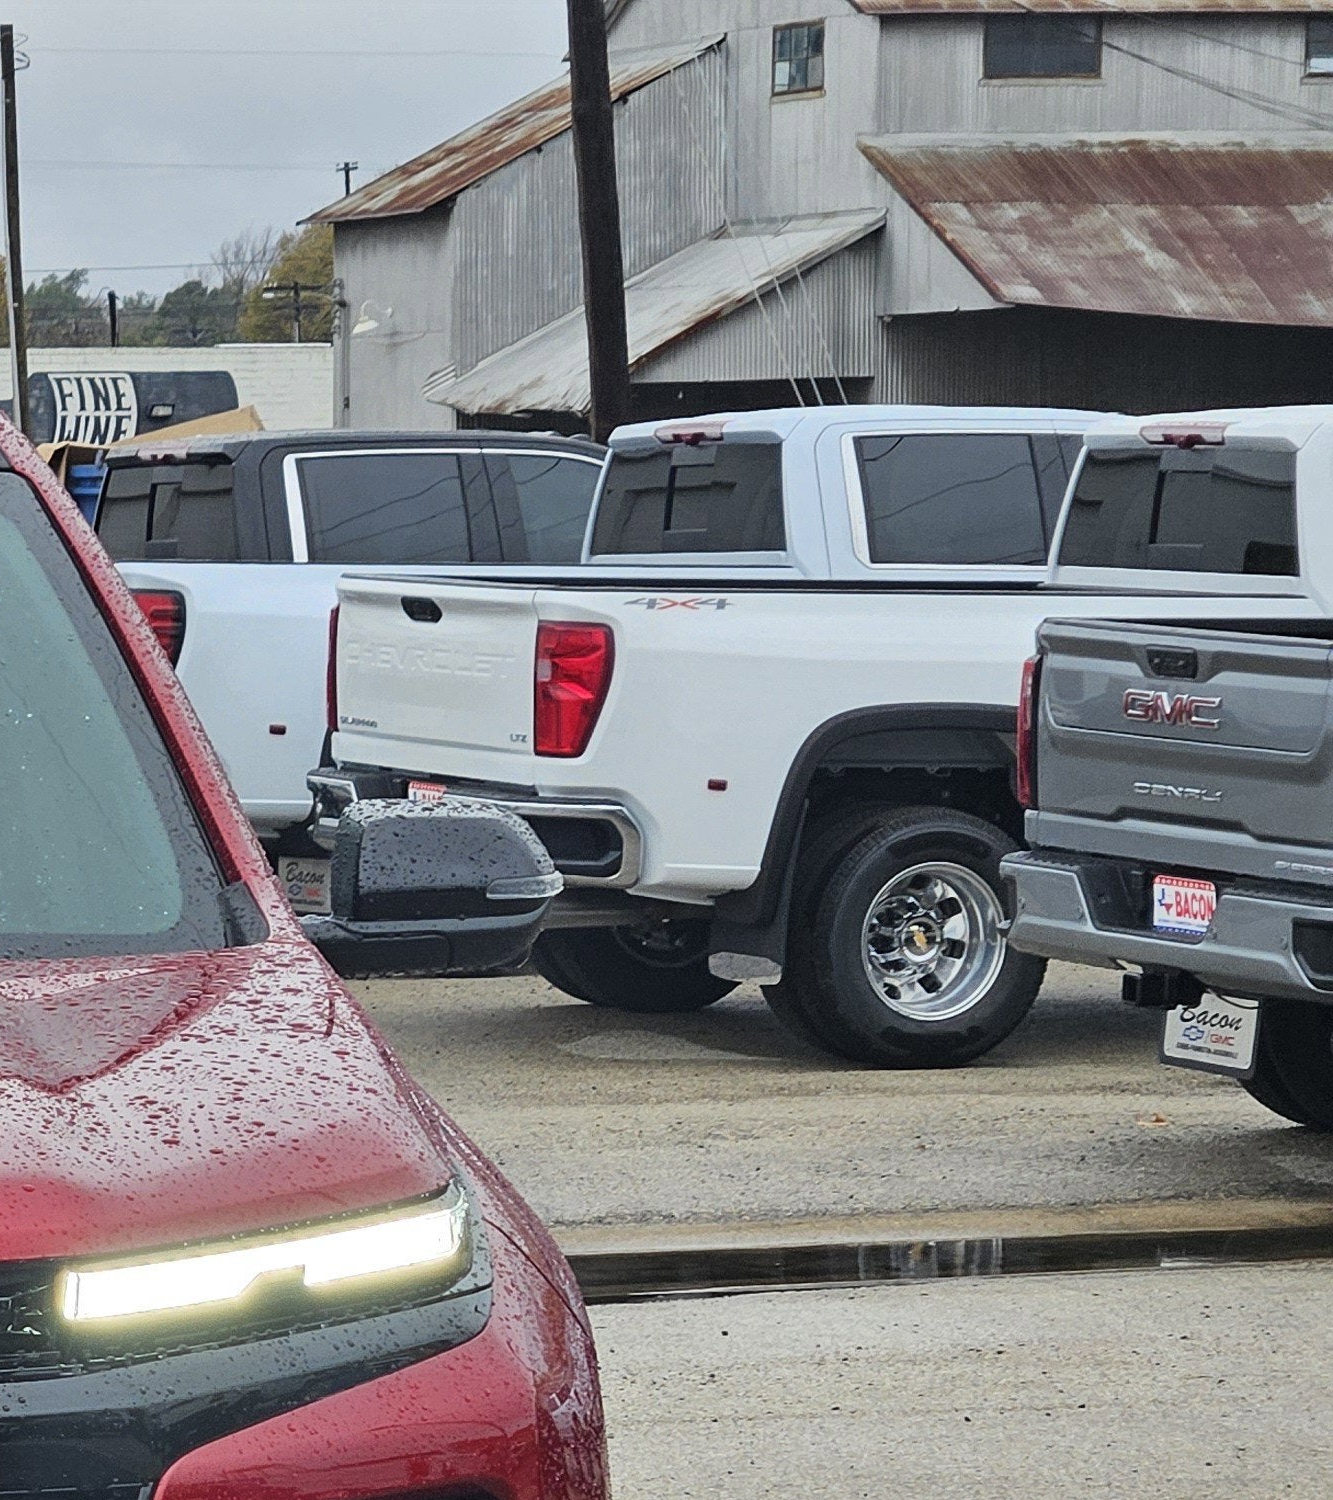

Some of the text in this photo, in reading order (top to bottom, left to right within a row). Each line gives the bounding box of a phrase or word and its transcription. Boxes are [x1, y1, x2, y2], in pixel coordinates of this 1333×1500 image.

[53, 377, 131, 411] FINE
[1123, 688, 1222, 729] GMC
[1133, 782, 1222, 801] DENALI
[1175, 891, 1214, 922] BACON
[1210, 1033, 1235, 1046] GMC
